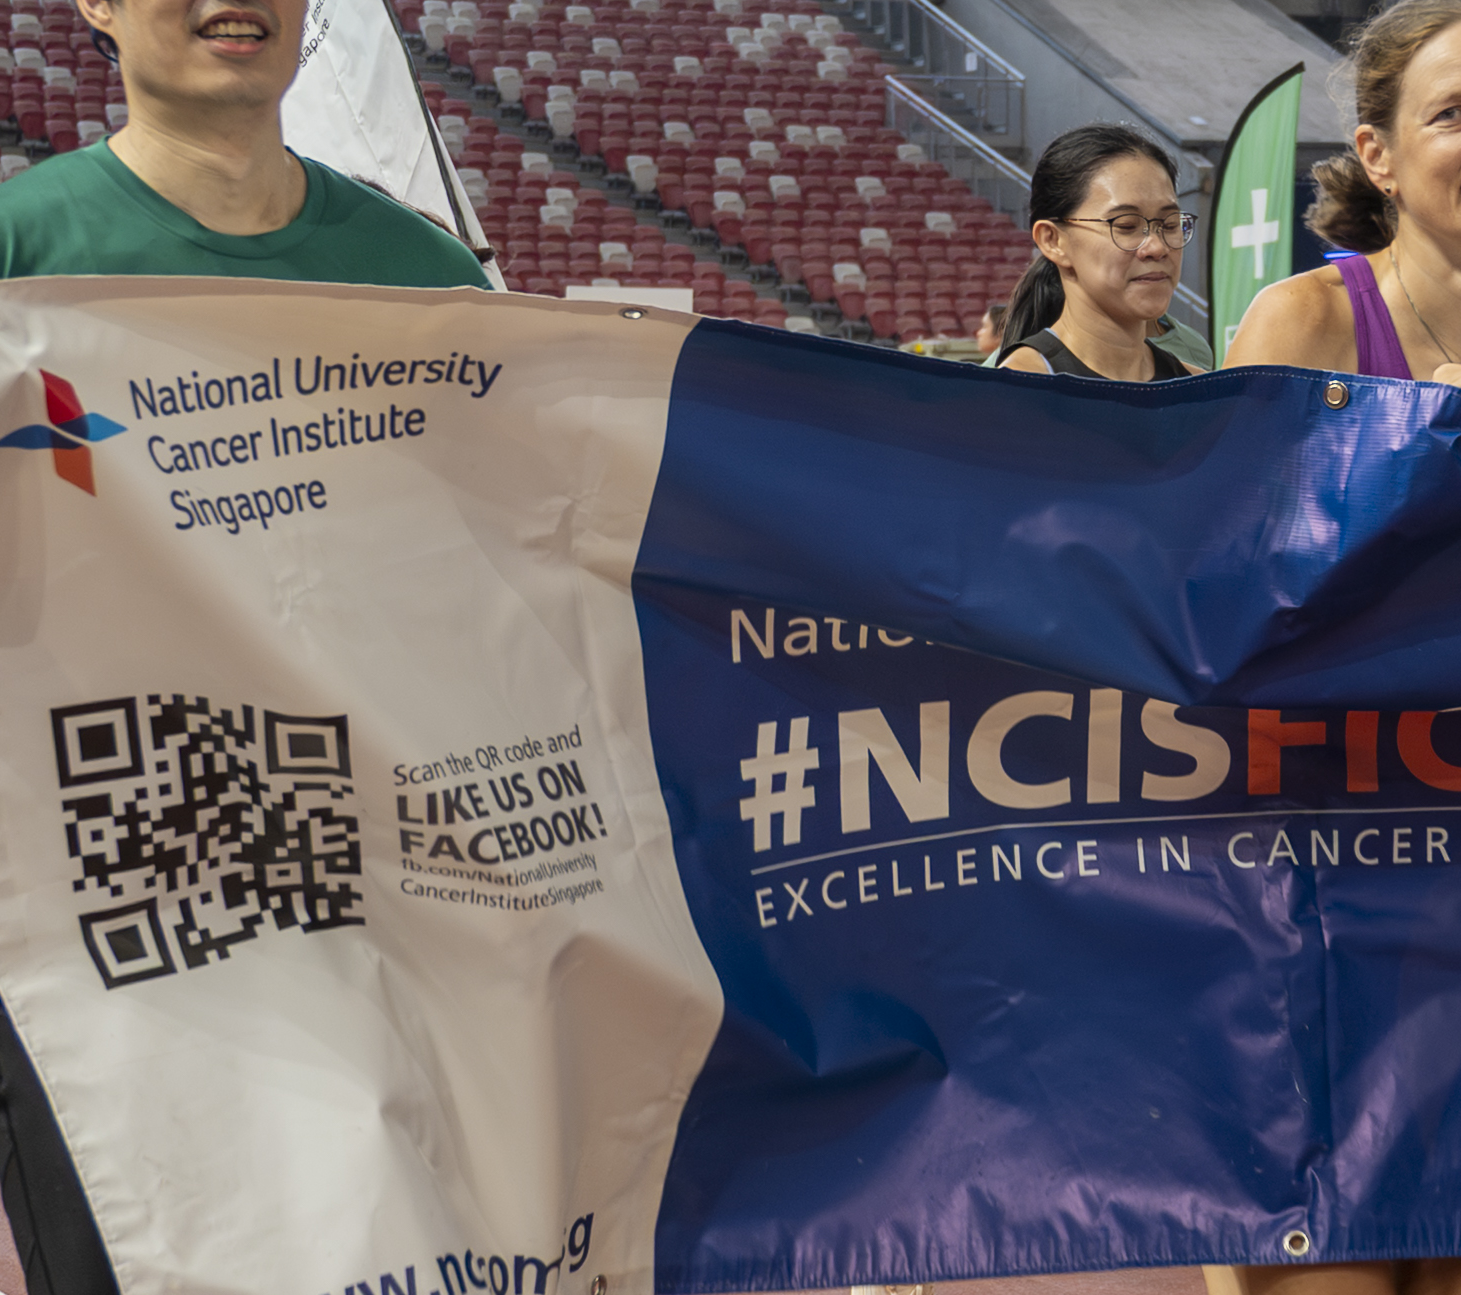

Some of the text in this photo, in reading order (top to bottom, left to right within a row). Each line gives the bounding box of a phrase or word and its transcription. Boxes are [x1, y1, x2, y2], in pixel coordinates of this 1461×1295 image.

[129, 351, 503, 420] National University
[148, 403, 427, 475] Cancer Institute
[170, 478, 328, 535] Singapore
[393, 723, 583, 787] Scan the QR code and
[396, 759, 587, 826] LIKE US ON
[399, 802, 608, 865] FACEBOOK!
[400, 877, 605, 912] CancerInstituteSingapore
[401, 852, 598, 888] fb.com/NationalUniversity
[754, 839, 1100, 929] EXCELLENCE
[1136, 835, 1192, 874] IN
[1227, 826, 1451, 869] CANCER
